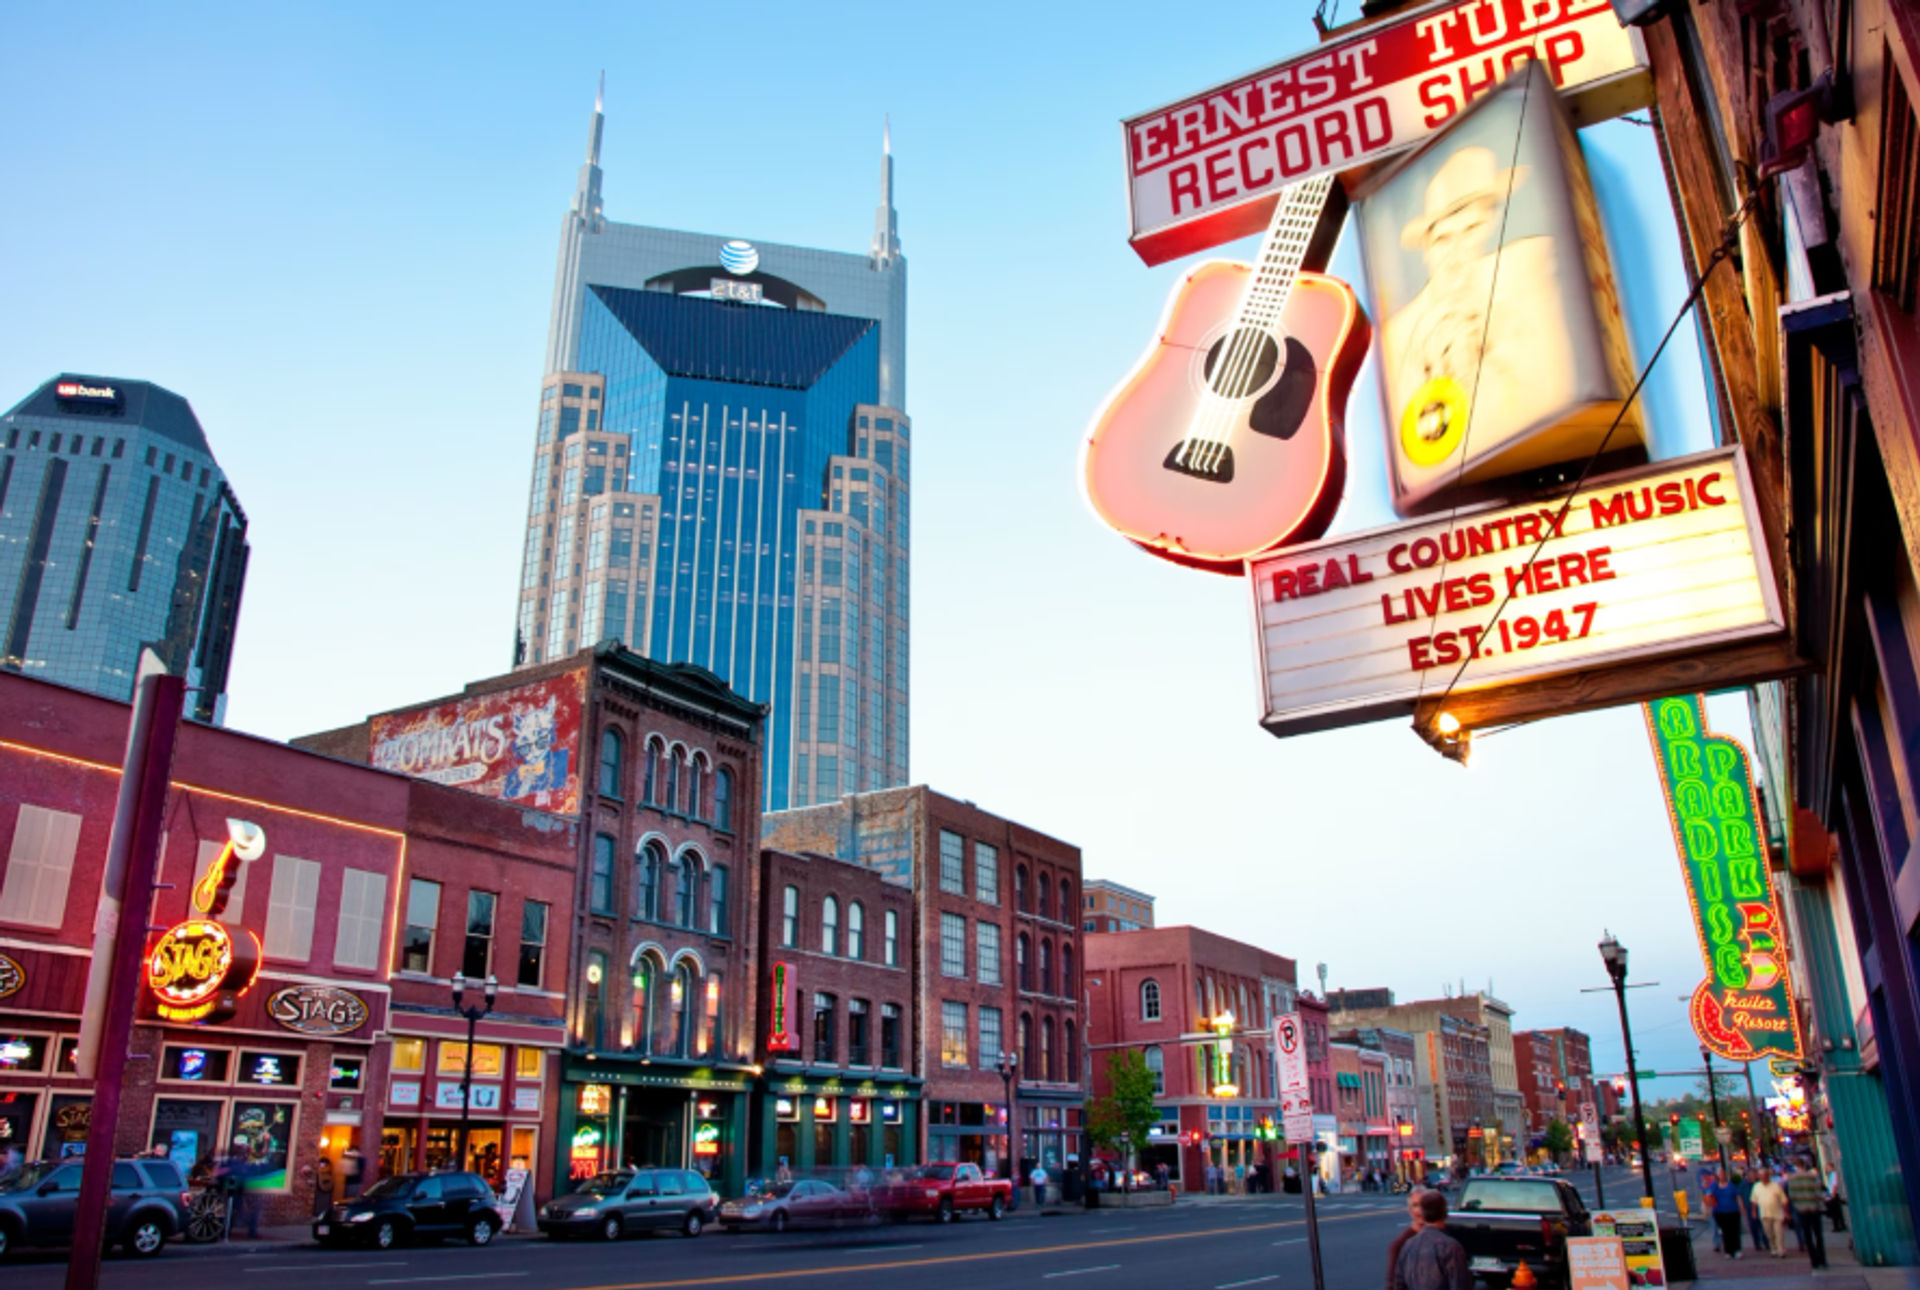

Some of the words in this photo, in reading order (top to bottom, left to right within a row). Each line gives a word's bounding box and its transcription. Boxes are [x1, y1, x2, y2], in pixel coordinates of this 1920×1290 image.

[1132, 39, 1378, 170] ERNEST
[1169, 96, 1394, 217] RECORD
[1272, 554, 1374, 603] REAL
[1386, 503, 1569, 575] COUNTRY
[1591, 472, 1727, 530] MUSIC
[1380, 574, 1496, 626] LIVES
[1505, 546, 1617, 600] HERE
[1659, 698, 1746, 989] ARADISE
[1705, 743, 1763, 898] PARK
[149, 935, 225, 988] STAGE
[1723, 989, 1777, 1011] Trailer
[275, 989, 364, 1024] STAGE
[1732, 1010, 1789, 1032] Resort
[570, 1160, 599, 1180] OPEN
